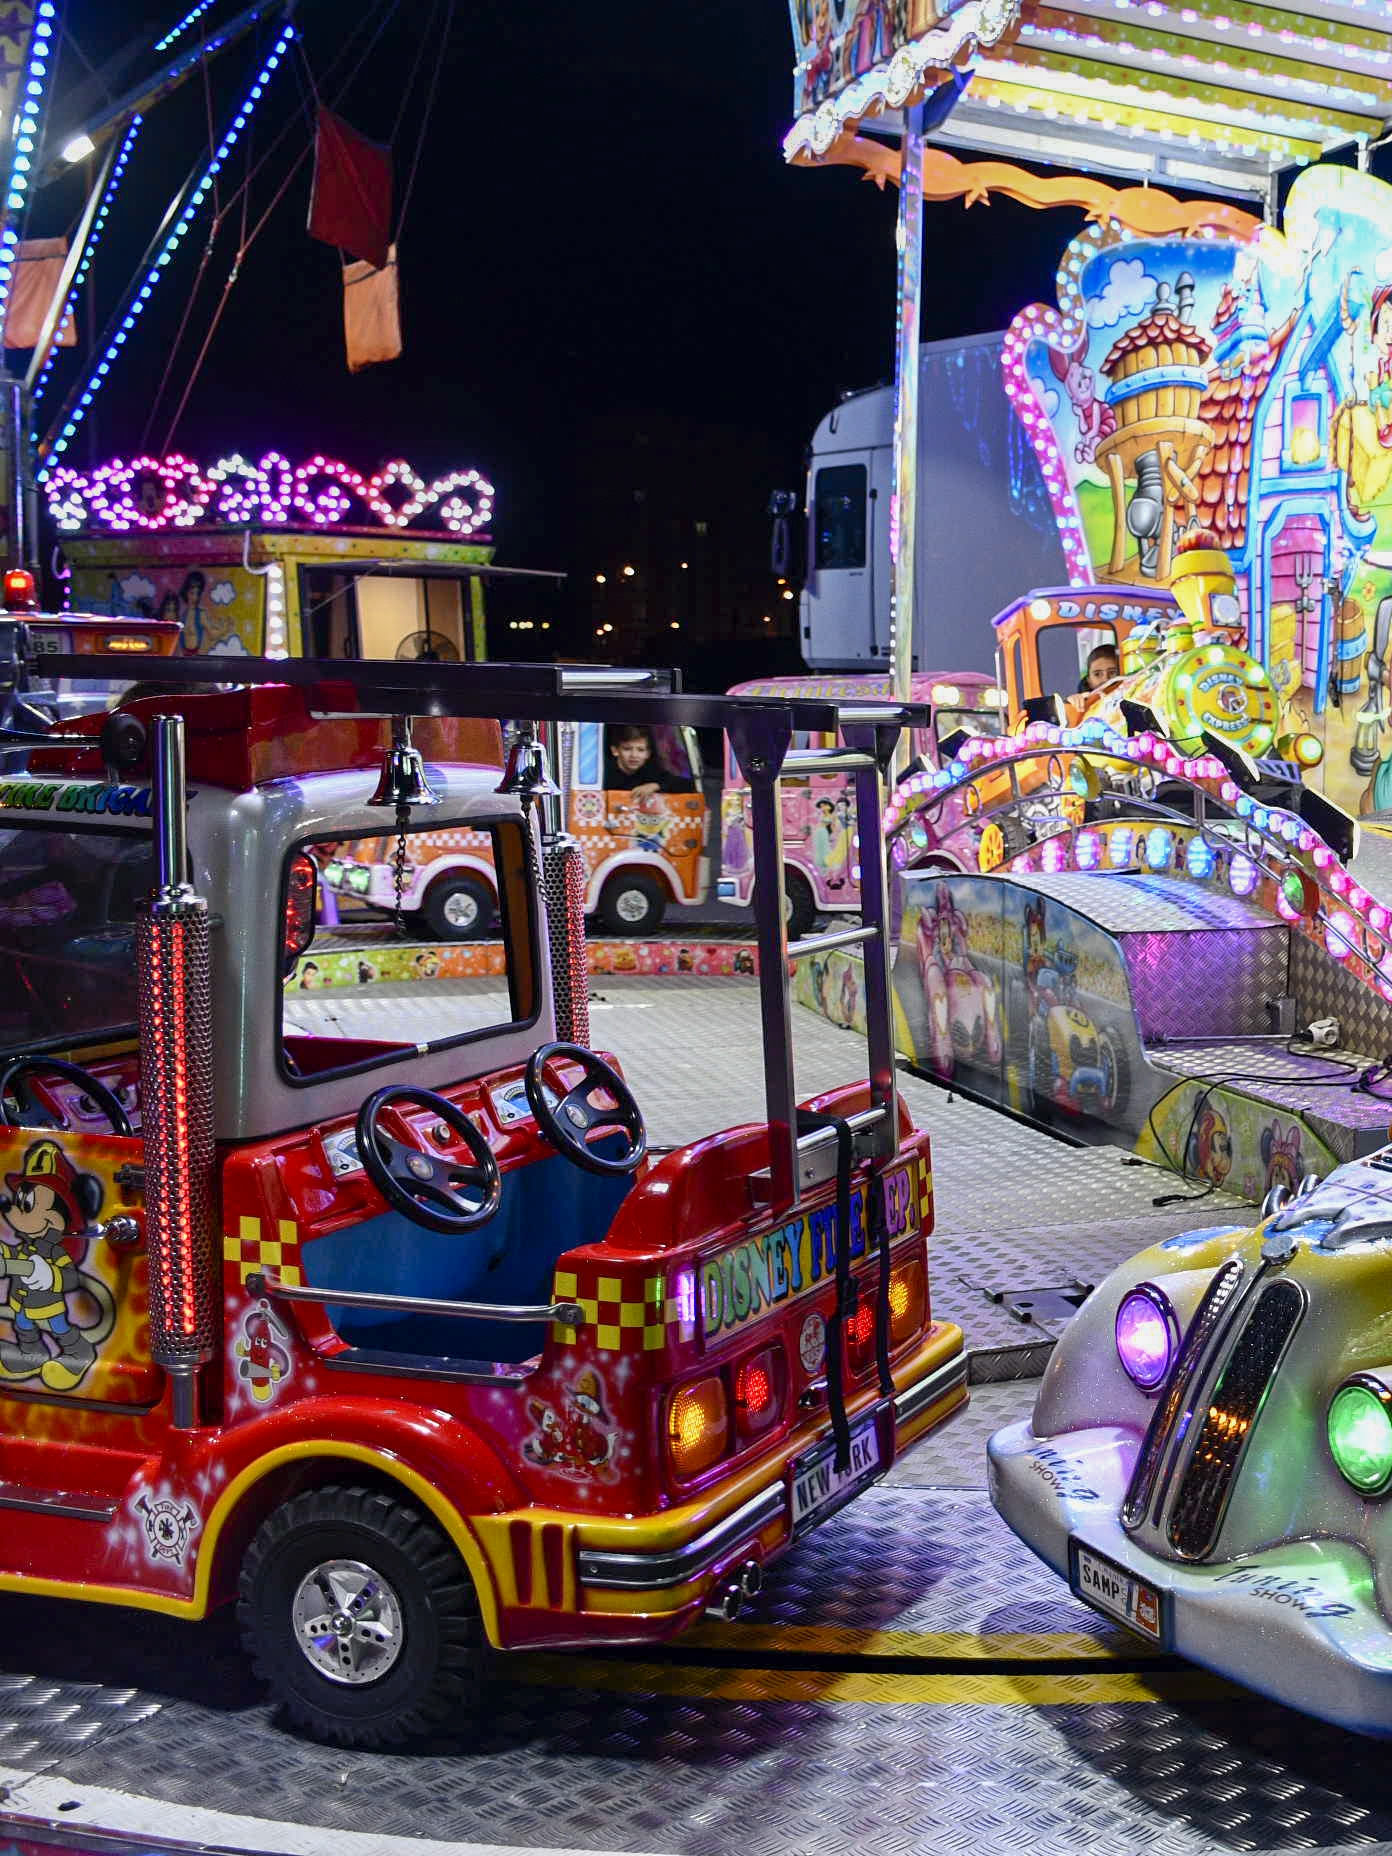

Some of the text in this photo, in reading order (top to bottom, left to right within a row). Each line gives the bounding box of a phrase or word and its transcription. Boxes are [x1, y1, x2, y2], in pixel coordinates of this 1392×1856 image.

[1058, 600, 1186, 621] DISNEY
[1198, 672, 1245, 693] DISNEY
[1202, 711, 1251, 732] EXPRESS
[703, 1168, 916, 1337] DISNEY FIE EP.
[796, 1462, 832, 1513] NEW
[1029, 1460, 1066, 1490] SHOW
[1082, 1563, 1121, 1600] SAMP
[1213, 1564, 1356, 1620] Tuning
[1249, 1586, 1314, 1612] SHOW
